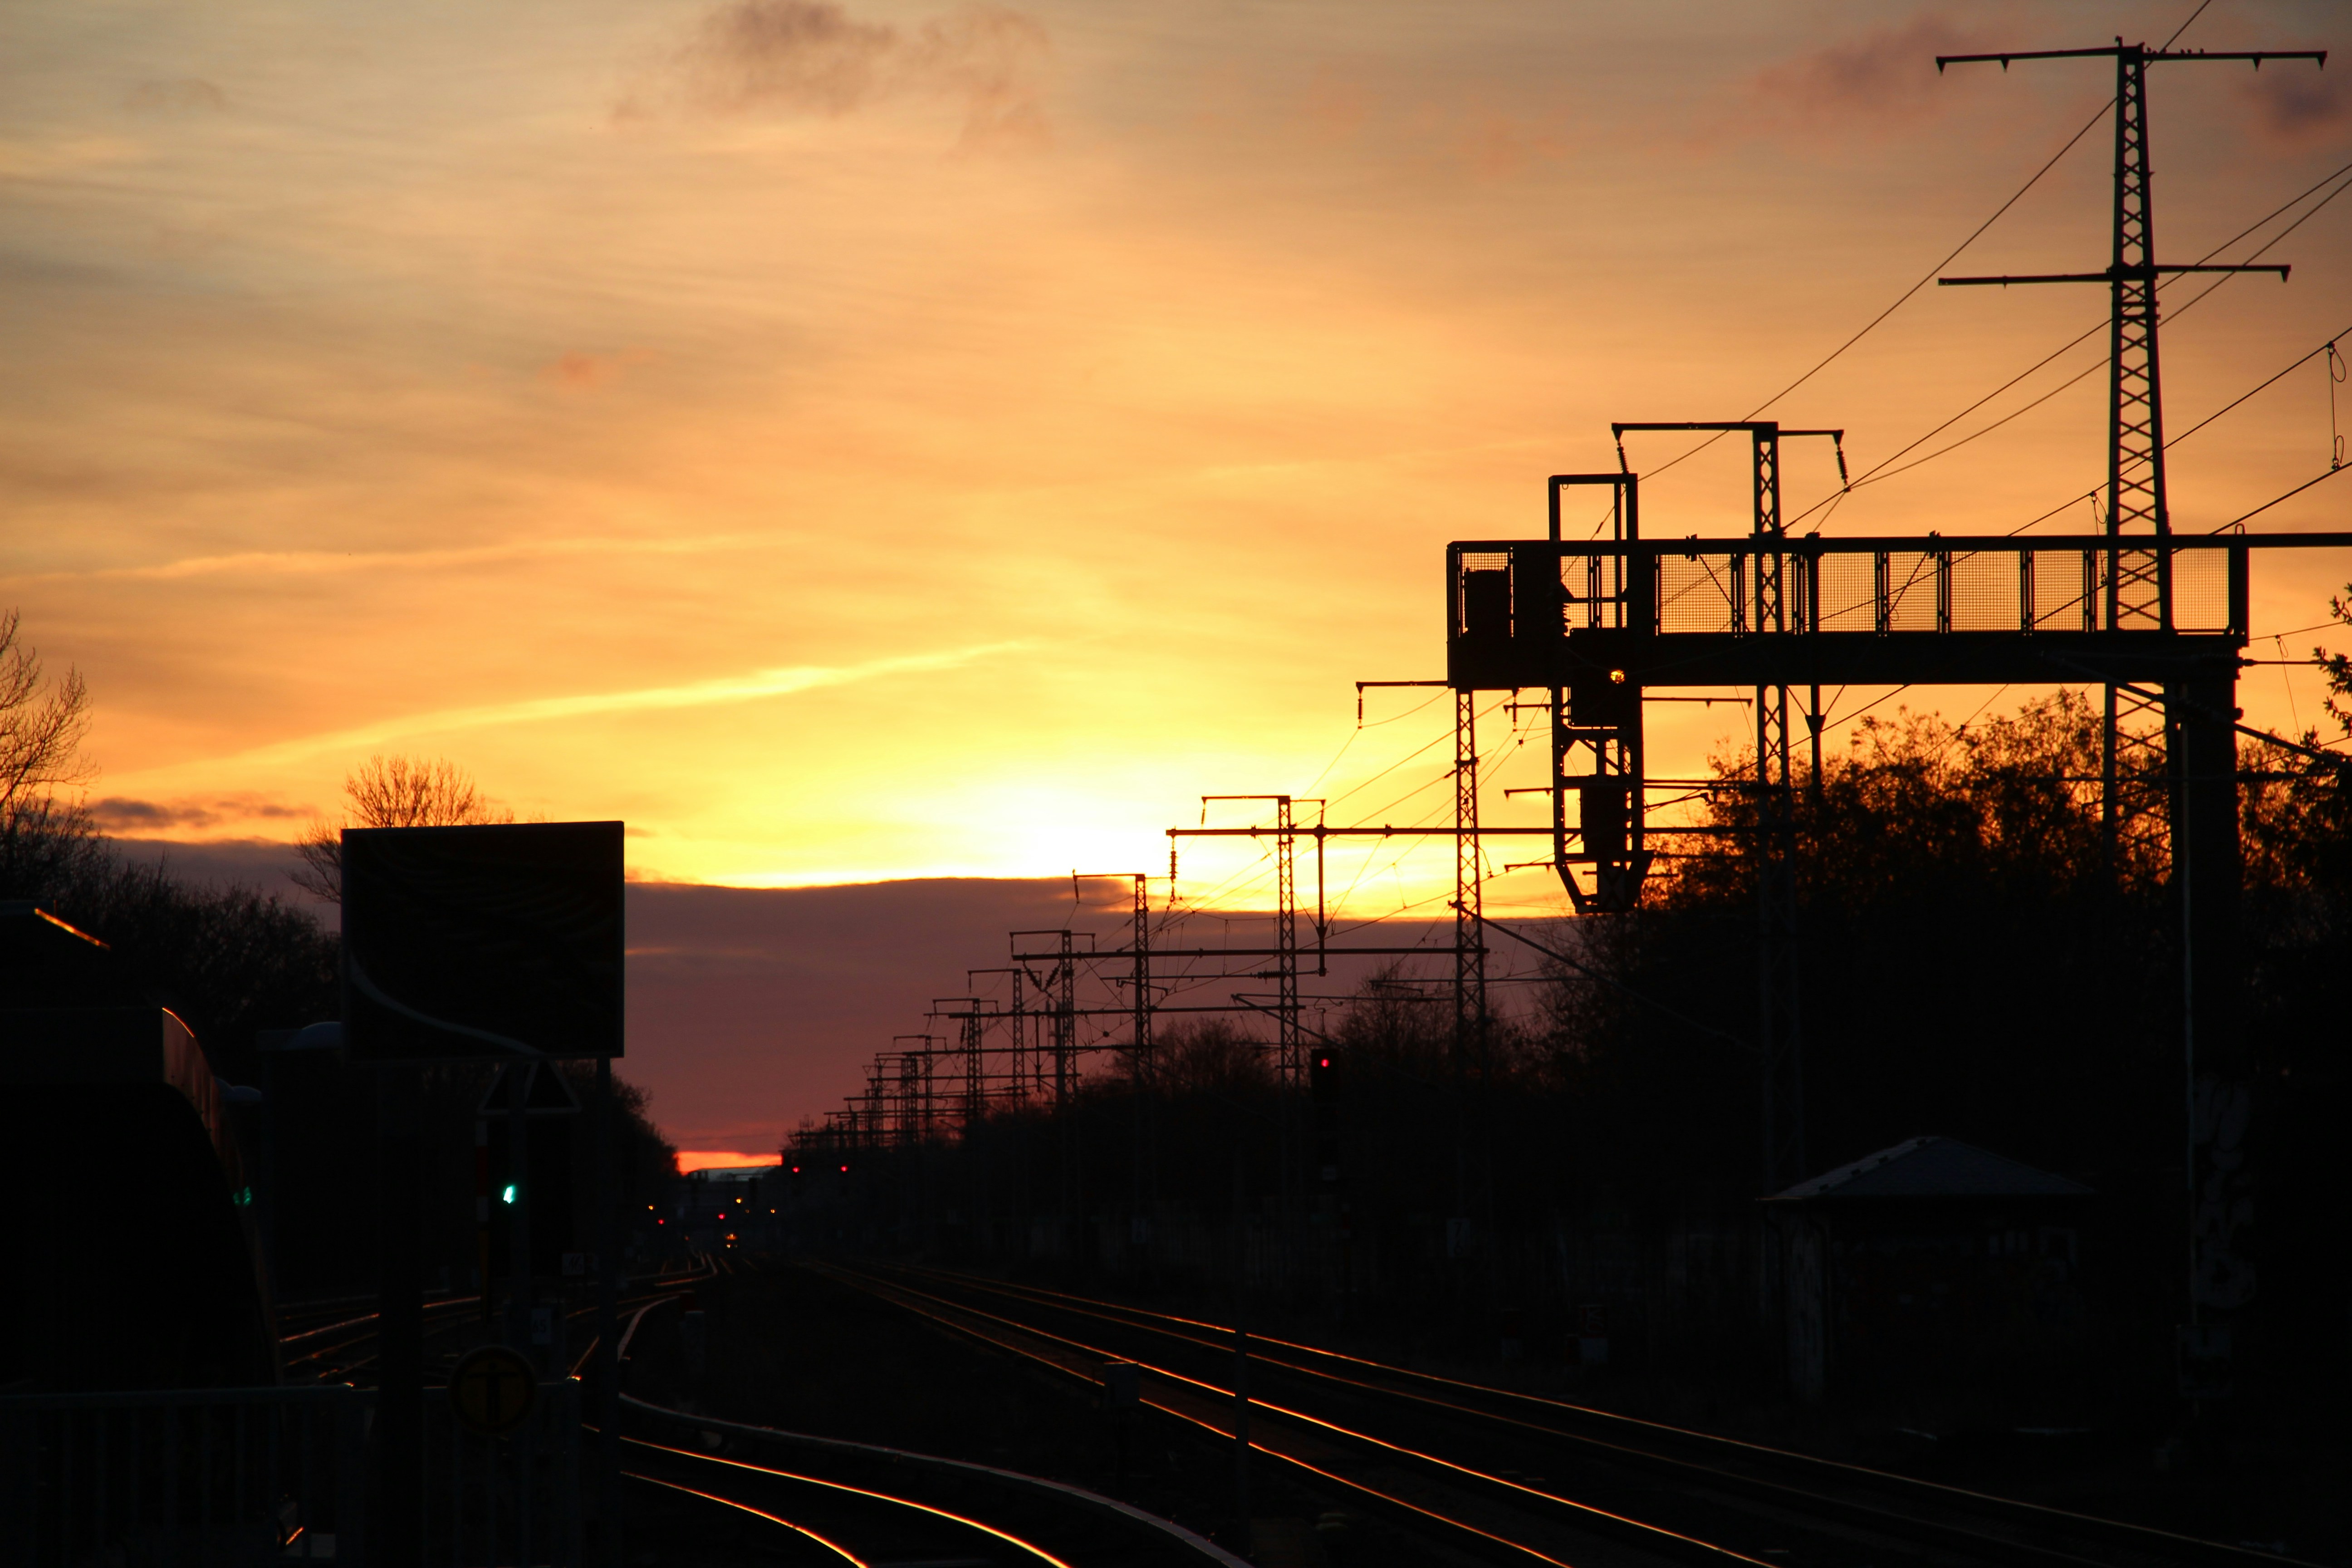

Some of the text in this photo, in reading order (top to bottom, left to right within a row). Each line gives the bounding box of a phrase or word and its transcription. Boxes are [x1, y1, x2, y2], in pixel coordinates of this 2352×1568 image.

[1454, 1222, 1462, 1238] 7
[1454, 1240, 1463, 1255] 6
[532, 1319, 547, 1333] 65
